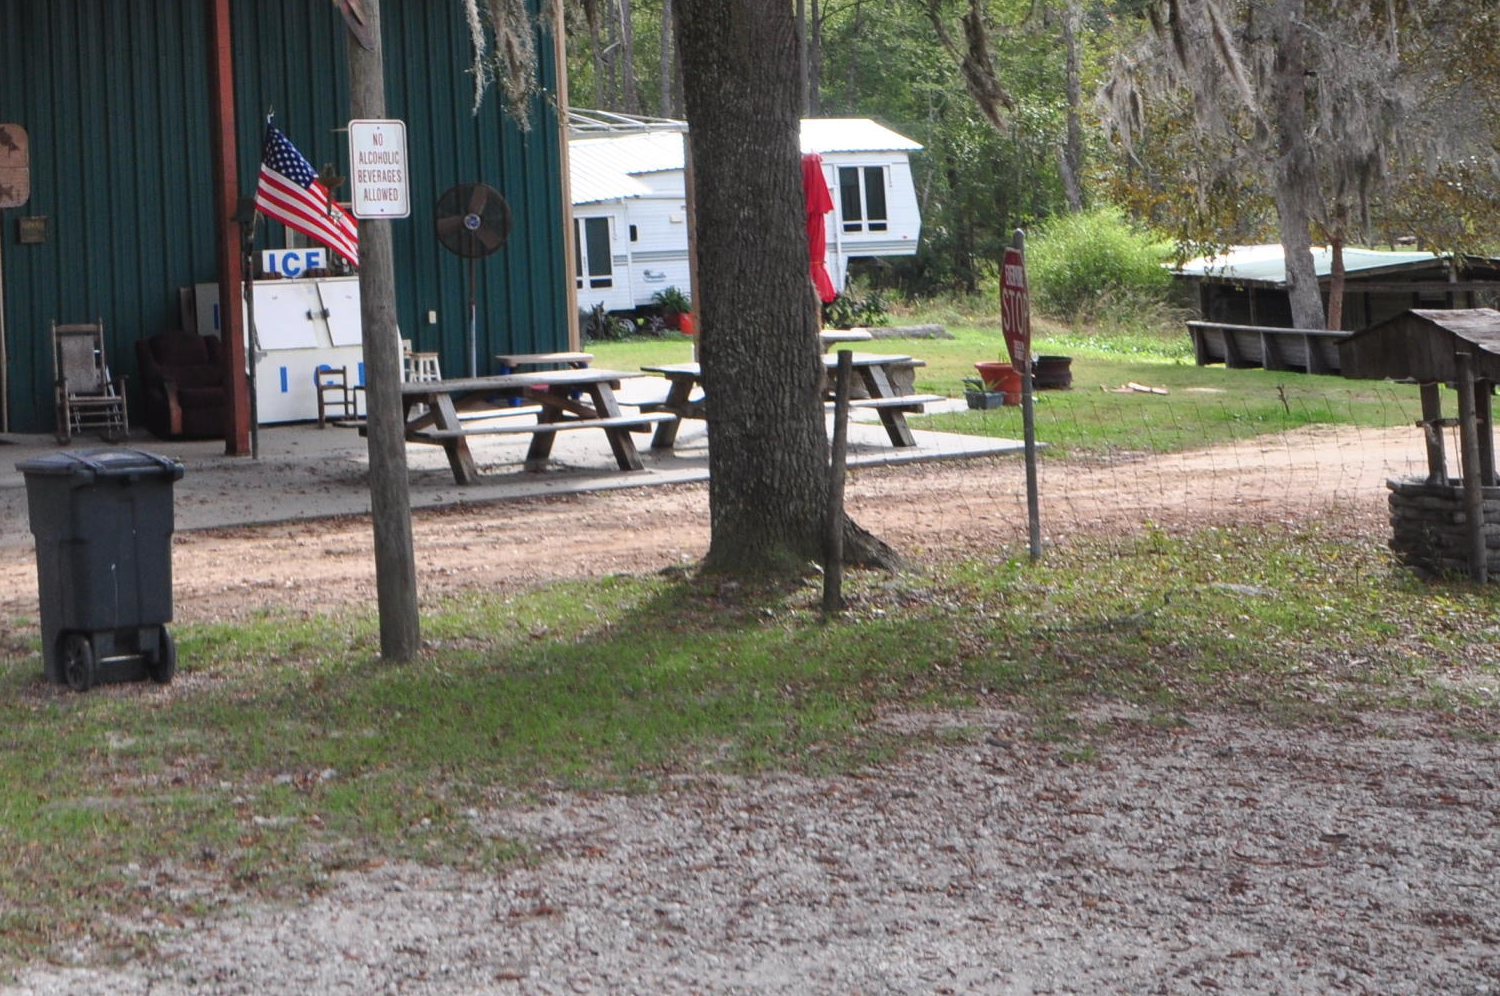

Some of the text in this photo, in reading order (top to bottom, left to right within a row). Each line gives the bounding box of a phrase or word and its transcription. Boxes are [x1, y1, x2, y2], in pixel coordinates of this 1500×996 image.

[372, 132, 384, 146] NO
[358, 150, 400, 165] ALCOHOLIC
[357, 169, 402, 183] BEVERAGES
[363, 187, 399, 202] ALLOWED
[268, 252, 320, 278] ICE
[1003, 288, 1028, 335] STOP
